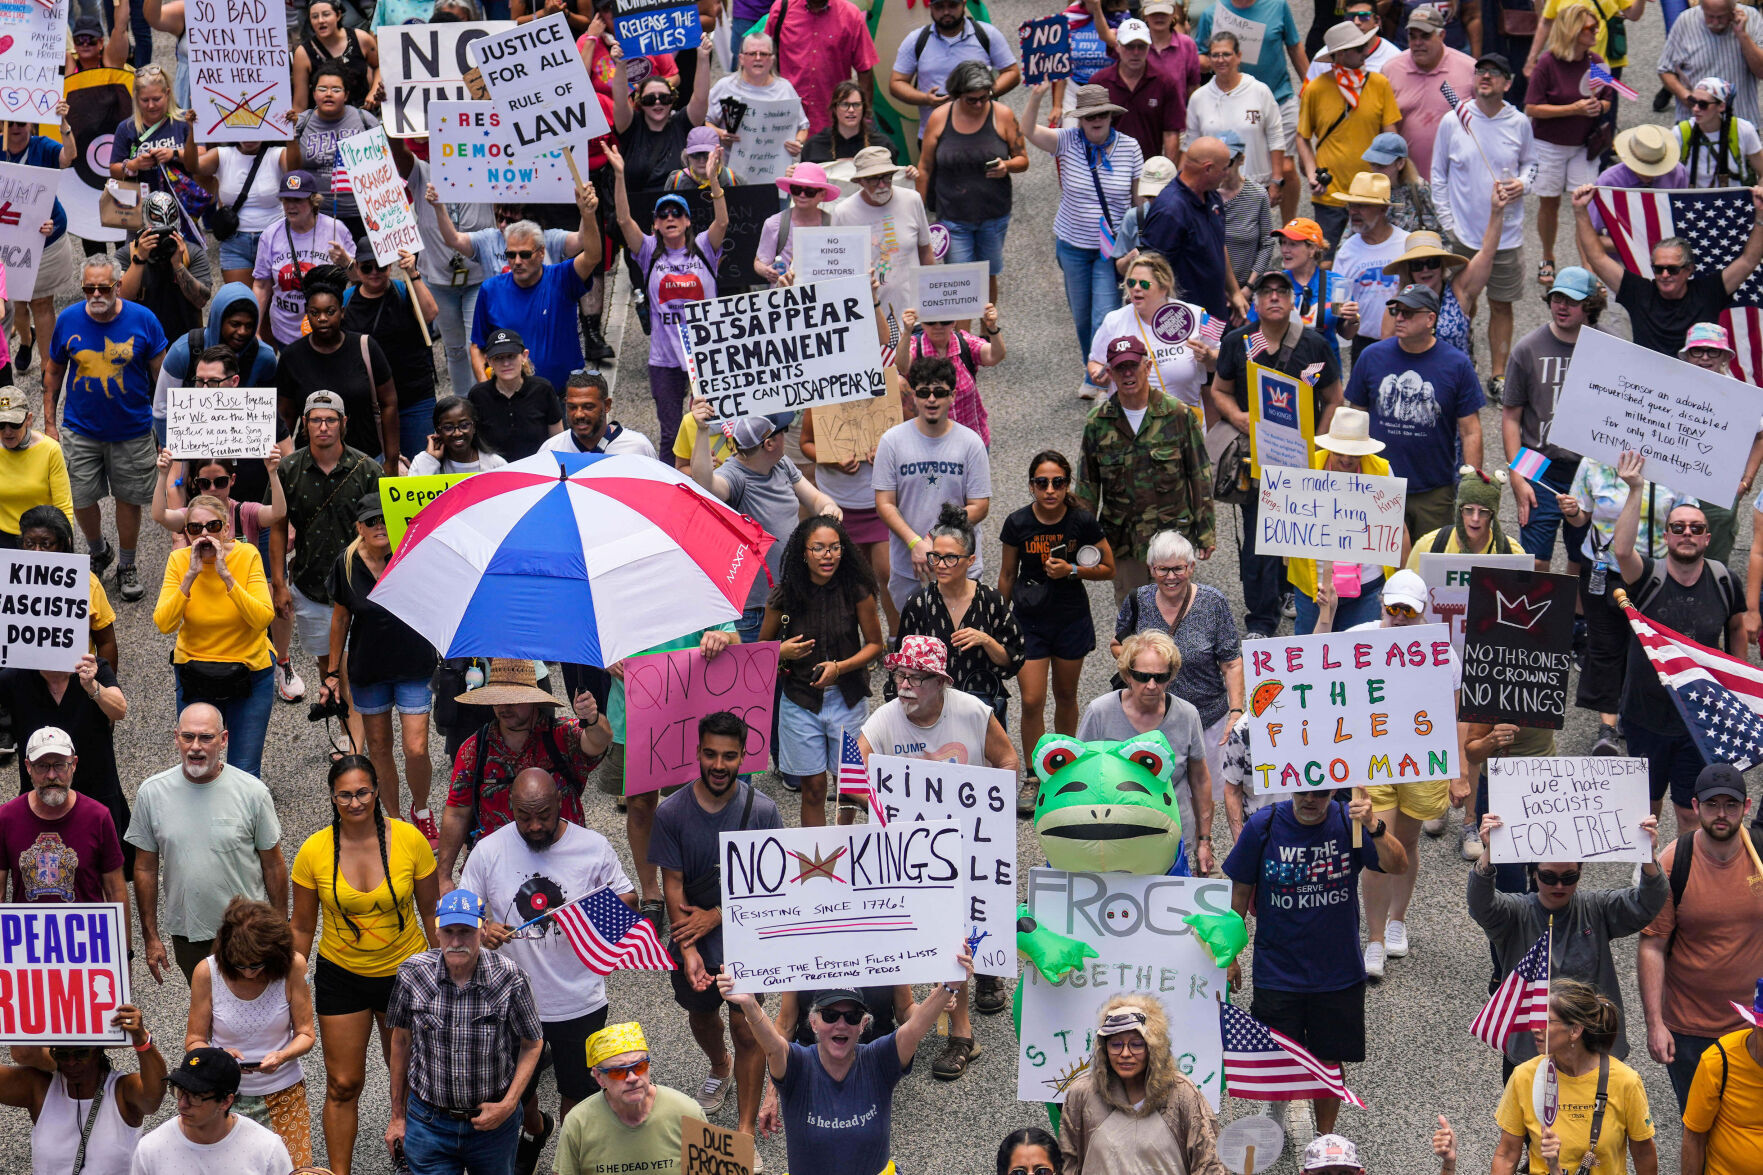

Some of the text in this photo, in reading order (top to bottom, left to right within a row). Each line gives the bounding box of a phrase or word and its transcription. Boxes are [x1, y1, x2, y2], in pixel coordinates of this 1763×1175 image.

[43, 8, 64, 19] ONE
[195, 0, 267, 24] SO BAD
[189, 27, 281, 47] EVEN THE
[619, 11, 696, 39] RELEASE THE
[1032, 24, 1062, 48] NO
[31, 33, 62, 42] PAYING
[41, 42, 56, 50] ME
[480, 23, 564, 65] JUSTICE
[639, 28, 686, 54] FILES
[192, 49, 286, 67] INTROVERTS
[488, 49, 574, 86] FOR ALL
[196, 67, 222, 85] ARE
[507, 82, 574, 112] RULE OF
[512, 101, 588, 147] LAW
[353, 164, 393, 194] ORANGE
[487, 167, 539, 183] NOW!
[372, 223, 420, 258] BUTTERFLY
[820, 247, 846, 255] KINGS!
[827, 237, 839, 245] NO
[812, 267, 856, 276] DICTATORS!
[665, 281, 697, 289] HATRED
[929, 280, 971, 289] DEFENDING
[683, 300, 712, 324] IF
[717, 293, 762, 319] ICE
[767, 284, 817, 309] CAN
[922, 296, 979, 307] CONSTITUTION
[691, 297, 865, 347] DISAPPEAR
[695, 326, 850, 378] PERMANENT
[700, 363, 805, 395] RESIDENTS
[1618, 375, 1655, 395] Sponsor
[1658, 389, 1669, 400] an
[172, 391, 194, 409] Let
[200, 396, 213, 409] us
[706, 373, 863, 421] ICE CAN DISAPPEAR
[172, 412, 185, 423] for
[190, 412, 207, 423] WE
[230, 413, 244, 421] the
[247, 412, 259, 420] Mt
[1268, 408, 1293, 421] NO KINGS
[1625, 409, 1706, 438] millennial TODAY
[1679, 409, 1728, 432] disabled
[231, 427, 243, 435] the
[1603, 417, 1646, 443] for only
[210, 447, 242, 457] Freedom
[1639, 445, 1713, 477] @mattyp316
[900, 461, 964, 476] COWBOYS
[1265, 470, 1376, 493] We made the
[1372, 490, 1385, 504] NO
[1284, 496, 1367, 532] last king
[1264, 517, 1400, 552] BOUNCE in 1776
[9, 562, 78, 588] KINGS
[726, 543, 749, 584] MAXFL
[7, 624, 75, 649] DOPES
[1252, 640, 1450, 676] RELEASE
[1465, 643, 1493, 663] NO
[1466, 663, 1489, 678] NO
[1292, 679, 1385, 709] THE
[1462, 681, 1491, 707] NO
[894, 742, 927, 756] DUMP
[1255, 749, 1448, 788] TACO MAN
[1530, 777, 1611, 794] we hate
[1522, 792, 1604, 818] Fascists
[1511, 809, 1633, 858] FOR FREE
[727, 828, 959, 895] NO KINGS
[1279, 840, 1338, 862] WE THE
[1264, 853, 1351, 885] PEOPLE
[1271, 888, 1349, 910] NO KINGS
[1296, 884, 1324, 894] SERVE
[813, 901, 851, 915] SINCE
[862, 896, 905, 911] 1776!
[1, 913, 111, 964] PEACH
[728, 948, 938, 981] RELEASE THE EPSTEIN FILES LISTS
[982, 950, 1006, 968] NO
[763, 965, 901, 987] QUIT PROTECTING PEDOS
[806, 1104, 877, 1129] is he dead yet?
[702, 1127, 734, 1157] DUE
[596, 1159, 674, 1174] IS HE DEAD YET?
